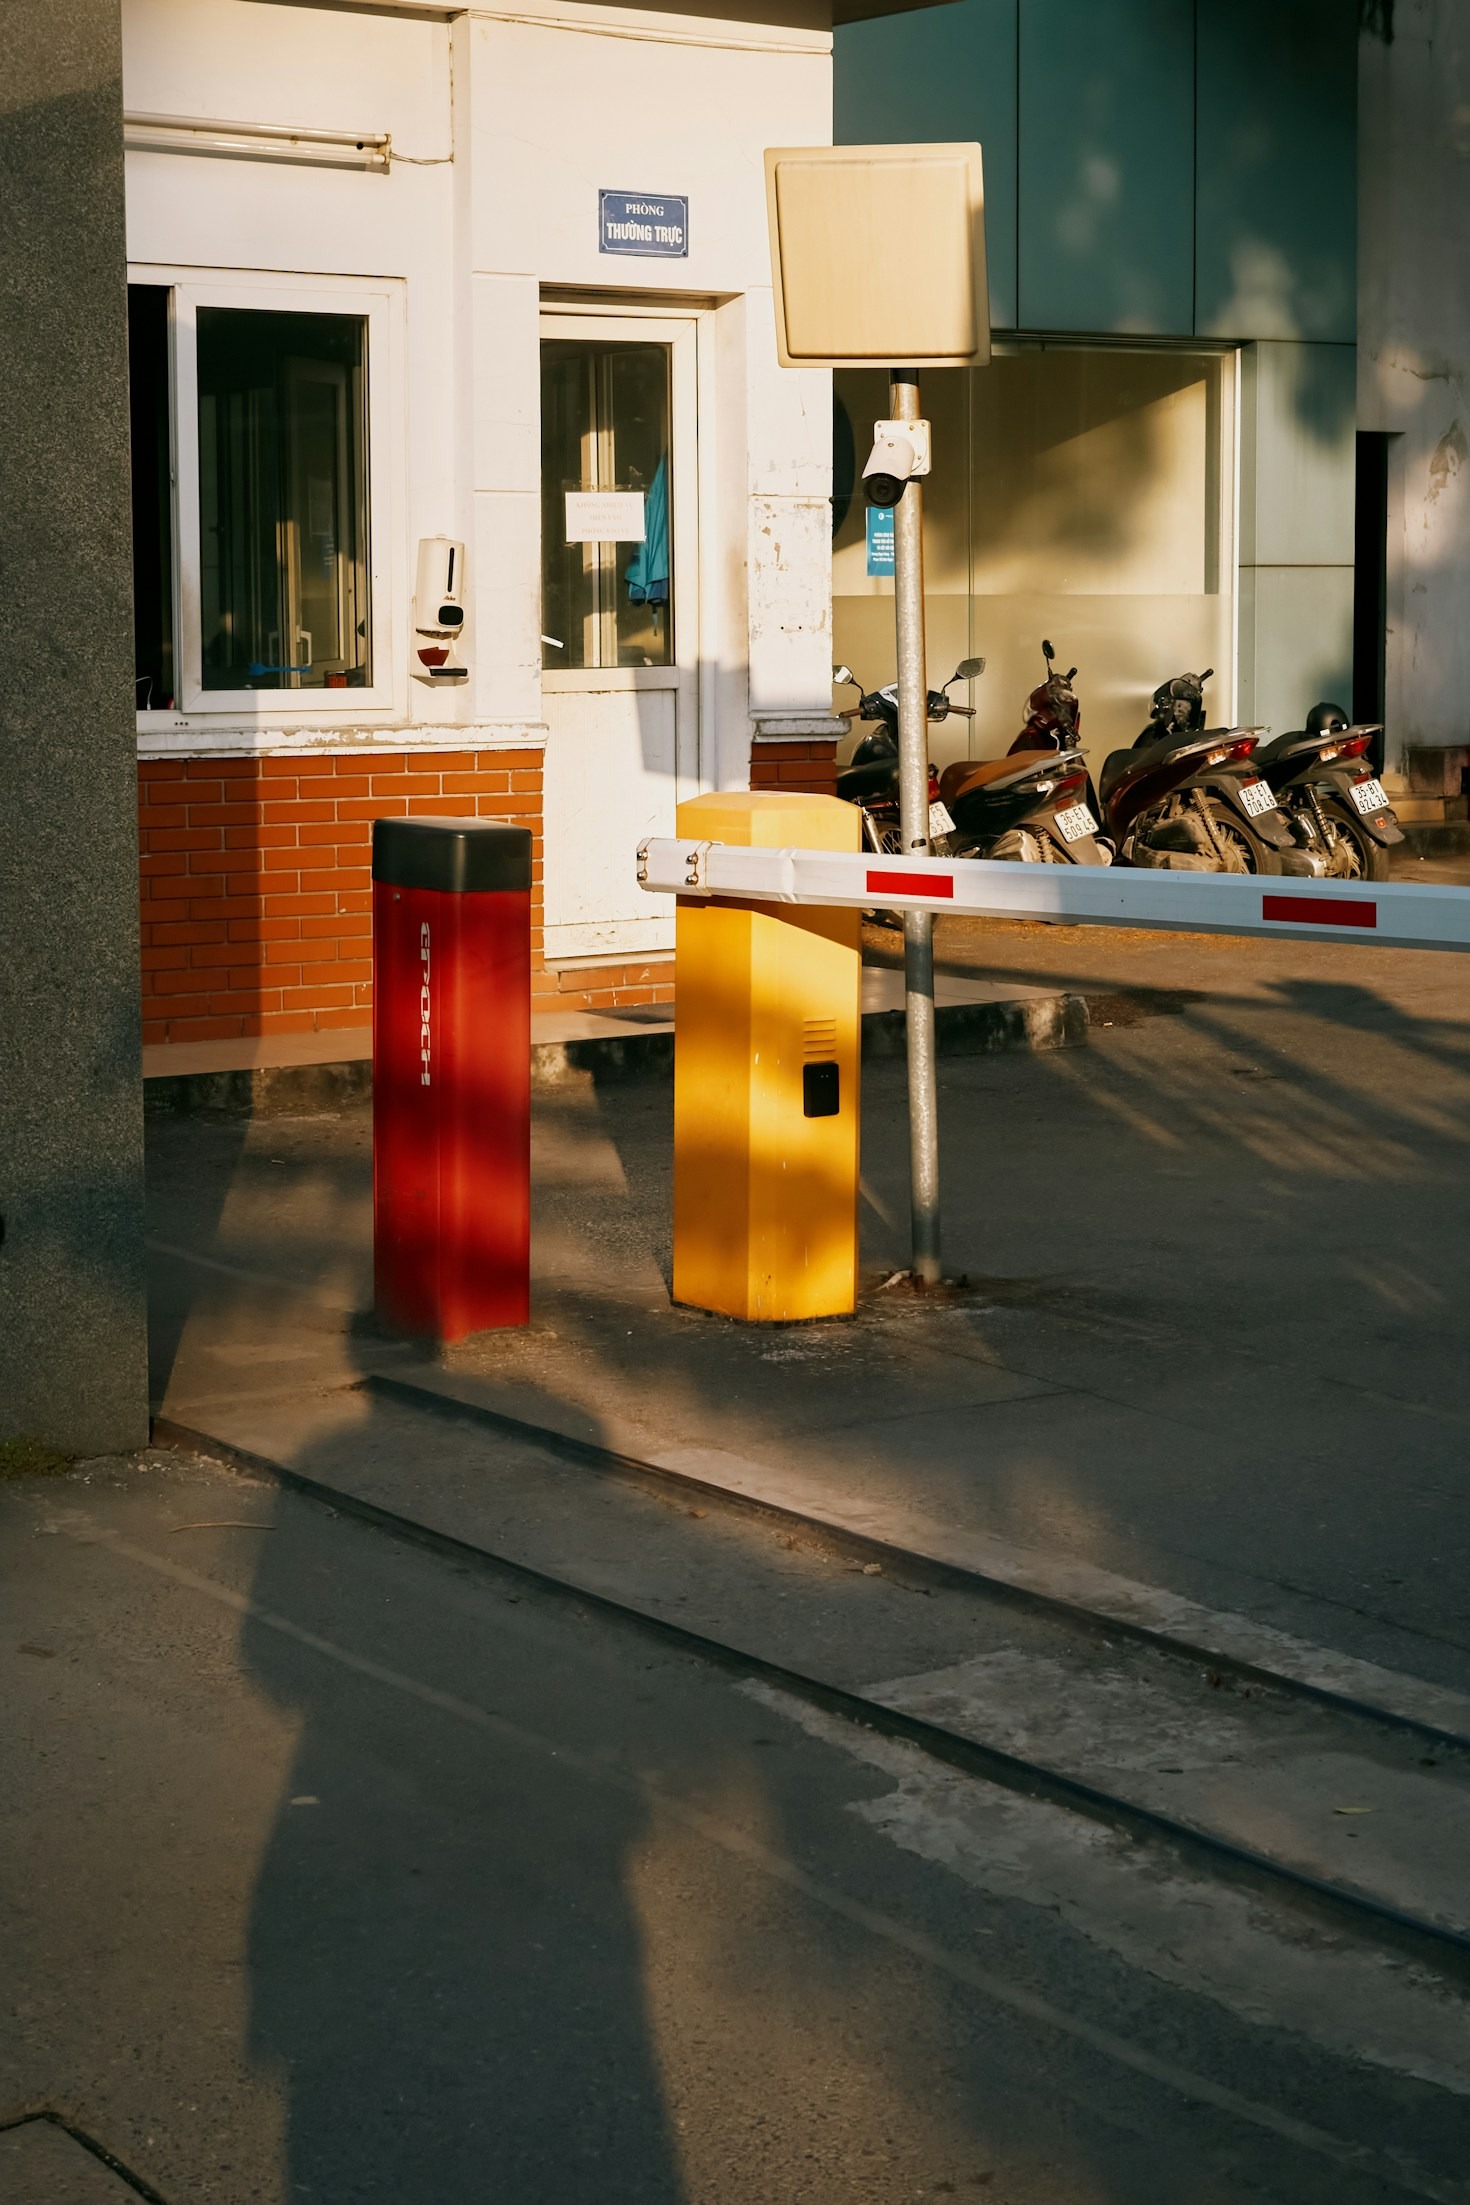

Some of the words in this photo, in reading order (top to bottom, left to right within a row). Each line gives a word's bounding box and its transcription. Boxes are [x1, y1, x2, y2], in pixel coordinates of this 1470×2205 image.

[625, 202, 664, 216] PHÒNG
[606, 220, 652, 241] THƯỜNG
[654, 225, 682, 247] TRỰC
[1243, 784, 1267, 802] 29-E1
[1355, 782, 1379, 799] 35-B1
[1359, 794, 1387, 812] 924.34
[1060, 807, 1086, 826] 36-E1
[1064, 818, 1096, 840] 509.45
